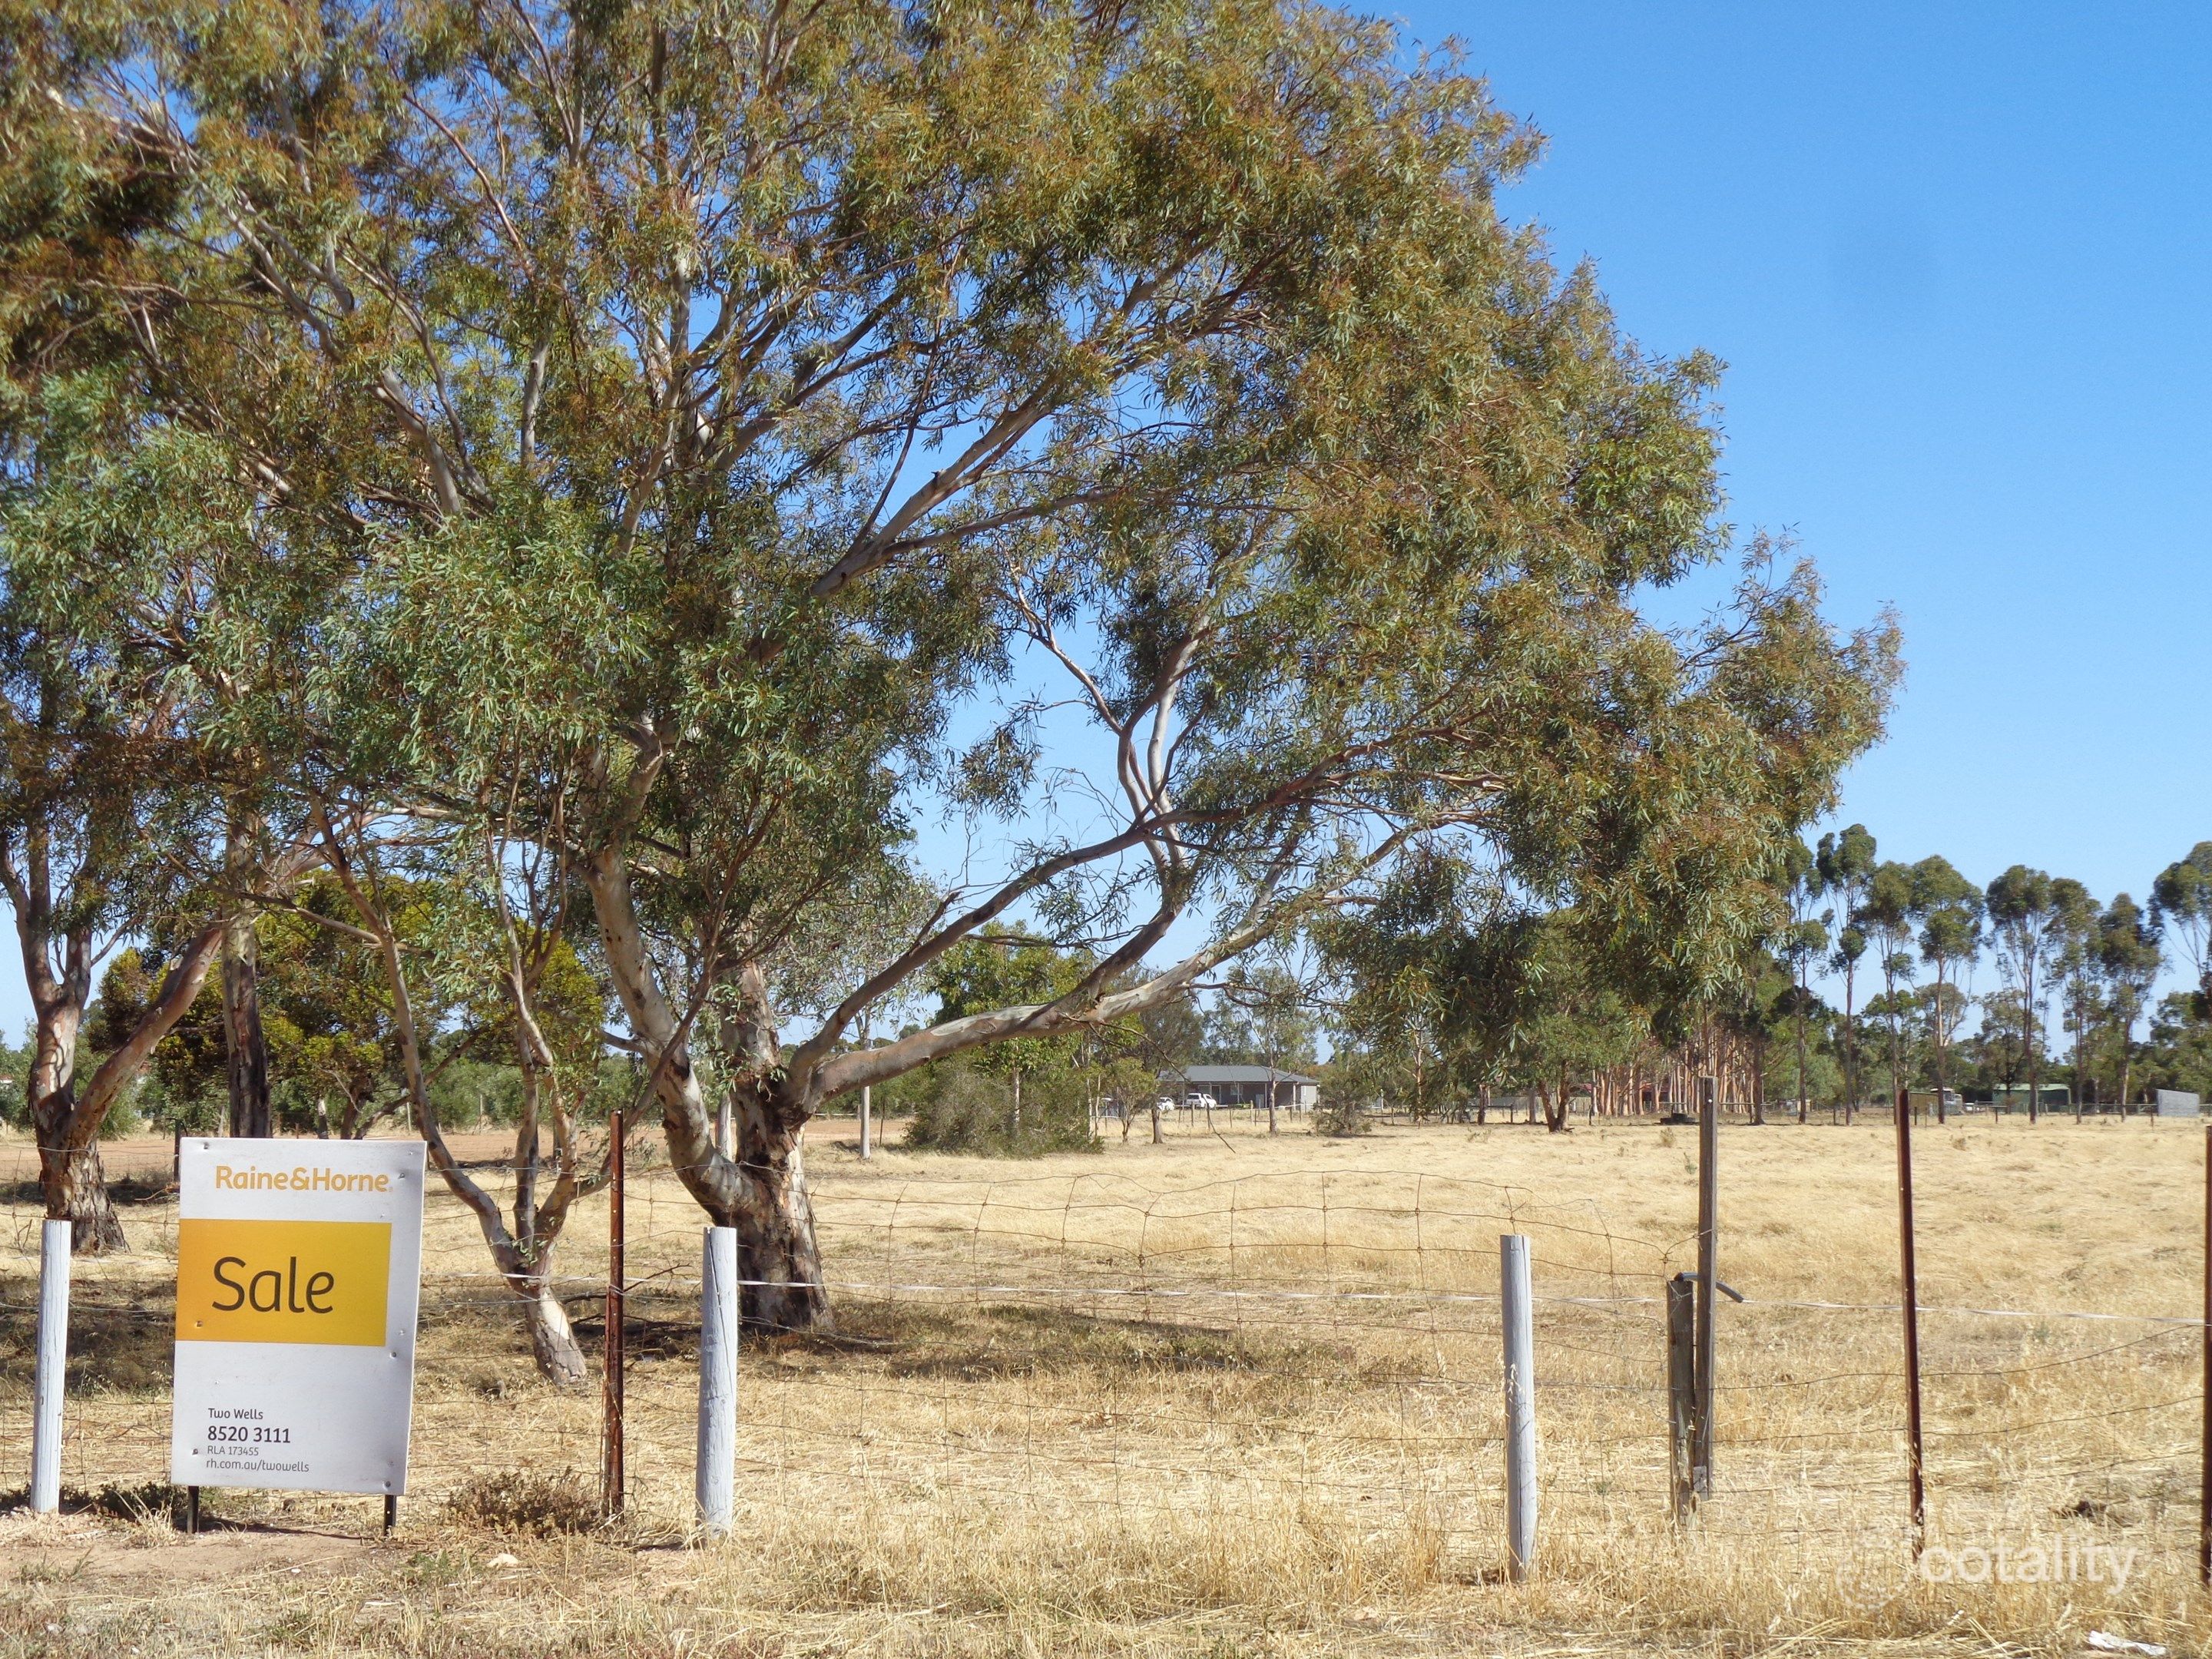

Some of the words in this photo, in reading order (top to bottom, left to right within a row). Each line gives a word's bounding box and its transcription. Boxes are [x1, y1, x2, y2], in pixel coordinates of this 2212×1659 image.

[212, 1257, 334, 1313] Sale
[208, 1408, 230, 1419] Two
[234, 1409, 263, 1419] Wells
[207, 1426, 248, 1442] 8520
[253, 1427, 291, 1443] 3111
[207, 1445, 226, 1455] RLA
[229, 1446, 259, 1455] 173455
[206, 1459, 310, 1472] rh.com.au/twowells
